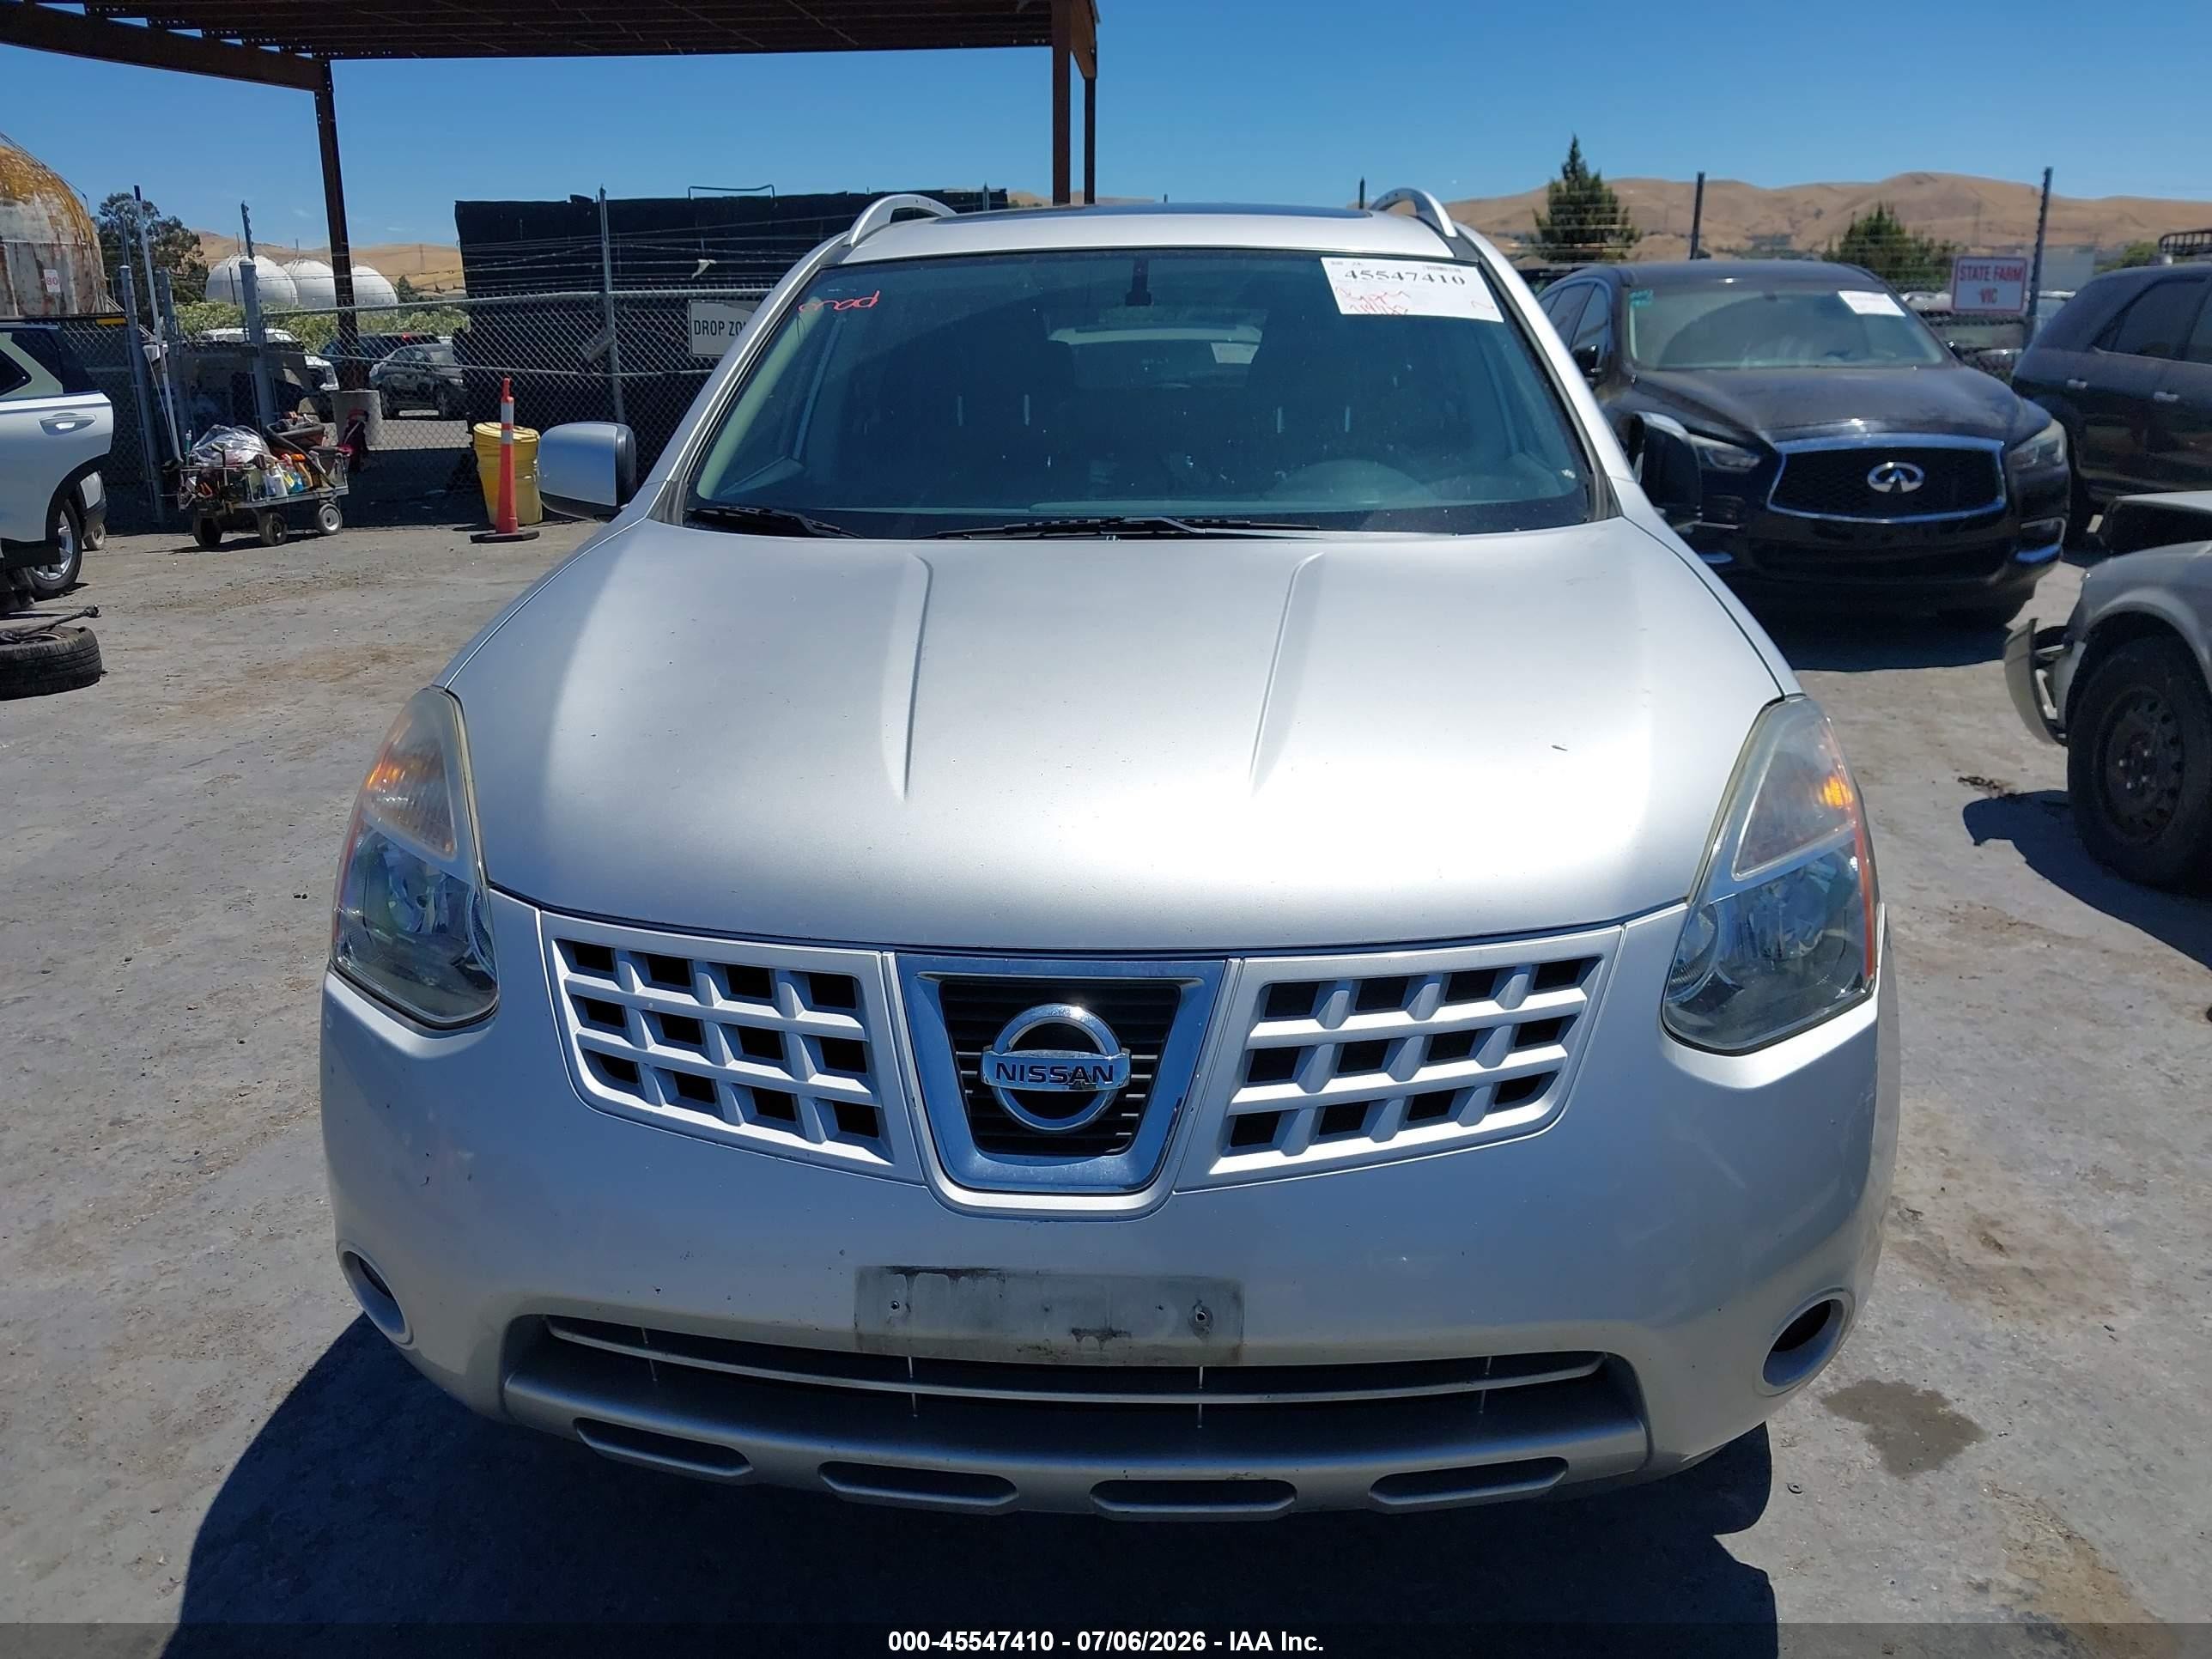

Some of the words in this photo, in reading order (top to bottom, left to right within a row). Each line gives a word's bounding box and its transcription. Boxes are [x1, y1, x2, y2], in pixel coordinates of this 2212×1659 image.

[1344, 269, 1466, 286] 45547410
[1959, 264, 1990, 283] STATE
[1994, 264, 2024, 283] FARM
[693, 319, 725, 337] DROP
[994, 1061, 1115, 1085] NISSAN
